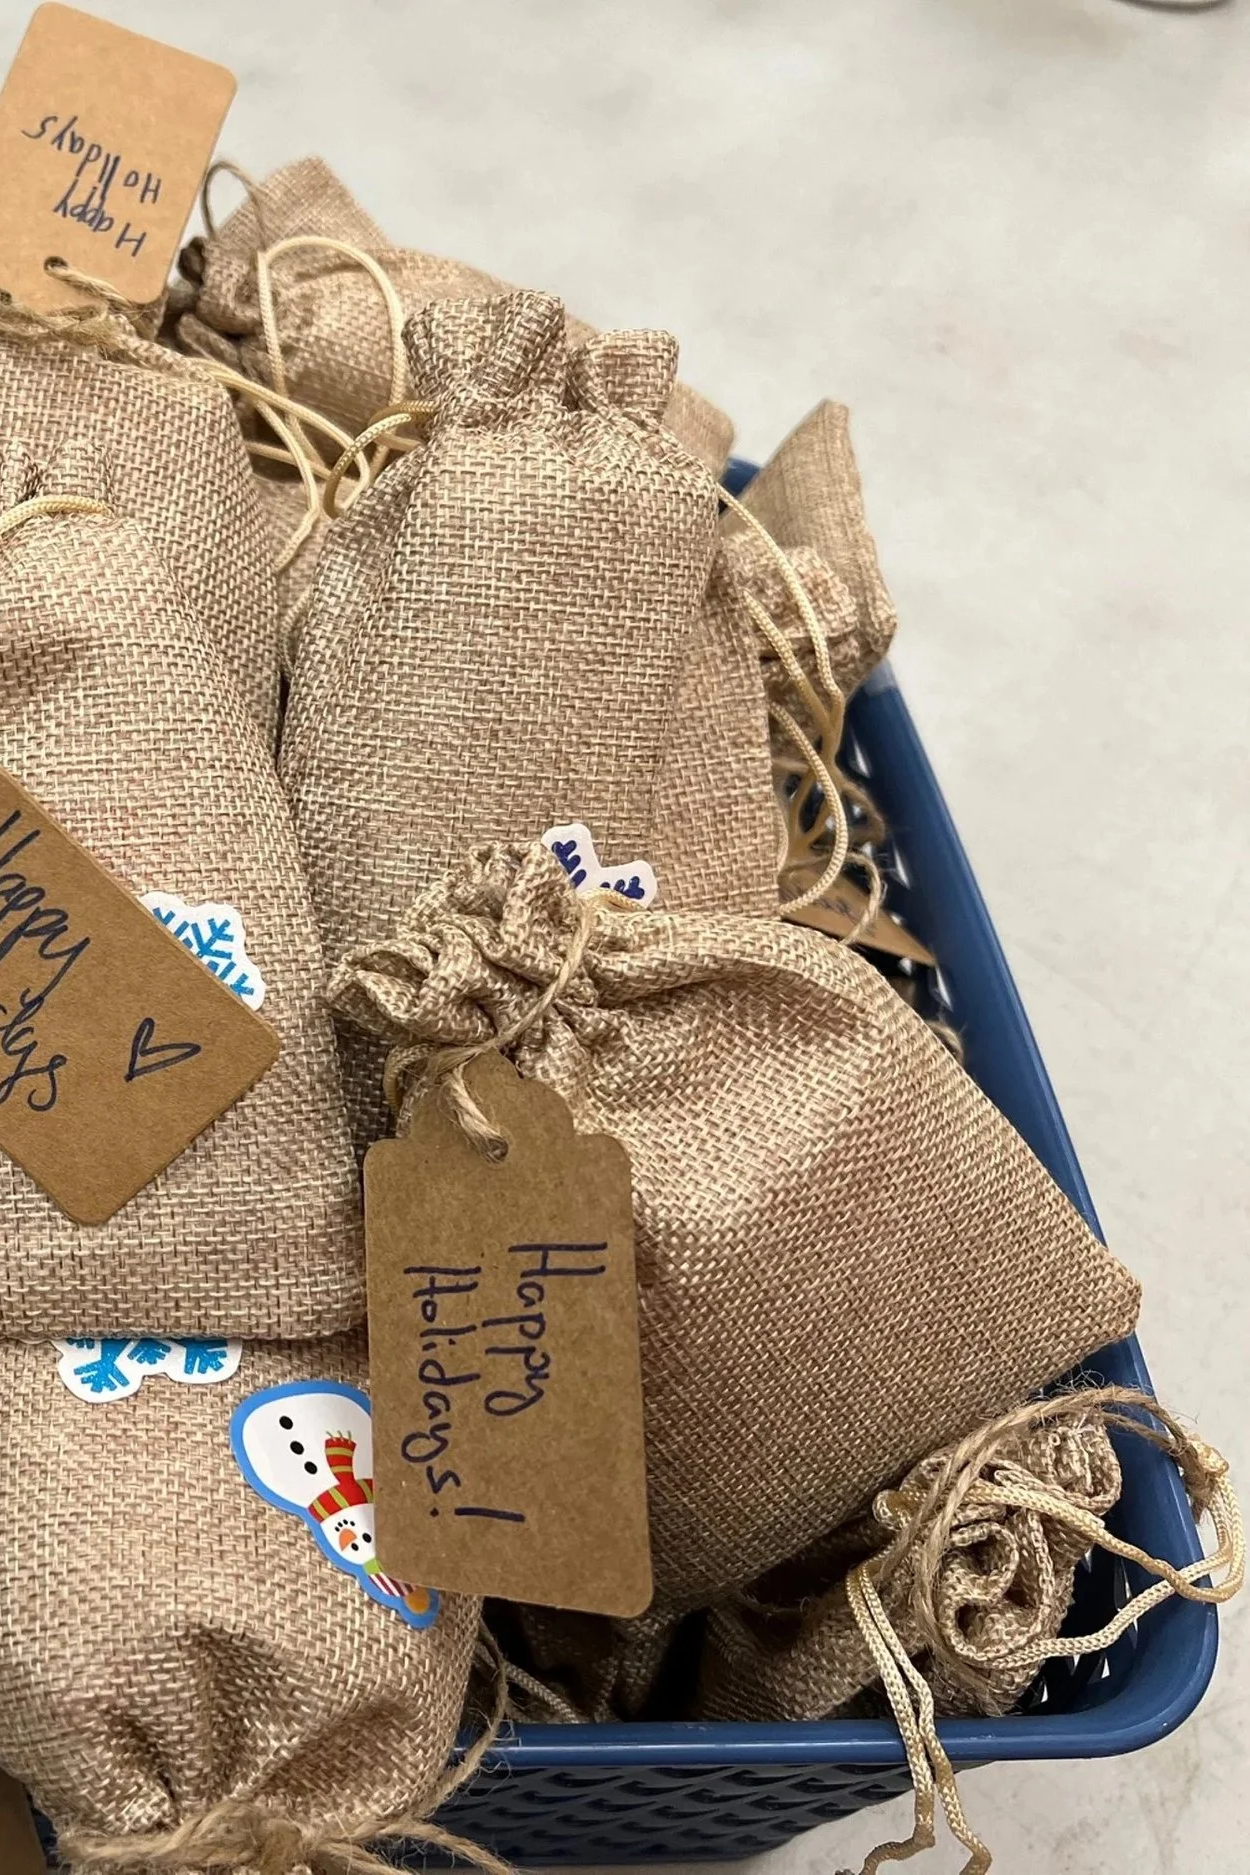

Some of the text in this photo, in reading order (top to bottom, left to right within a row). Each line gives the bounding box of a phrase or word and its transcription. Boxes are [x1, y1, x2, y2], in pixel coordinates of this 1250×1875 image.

[20, 114, 162, 204] Holidays
[53, 178, 148, 258] Happy
[401, 1265, 526, 1523] Holidays!
[481, 1242, 608, 1417] Happy
